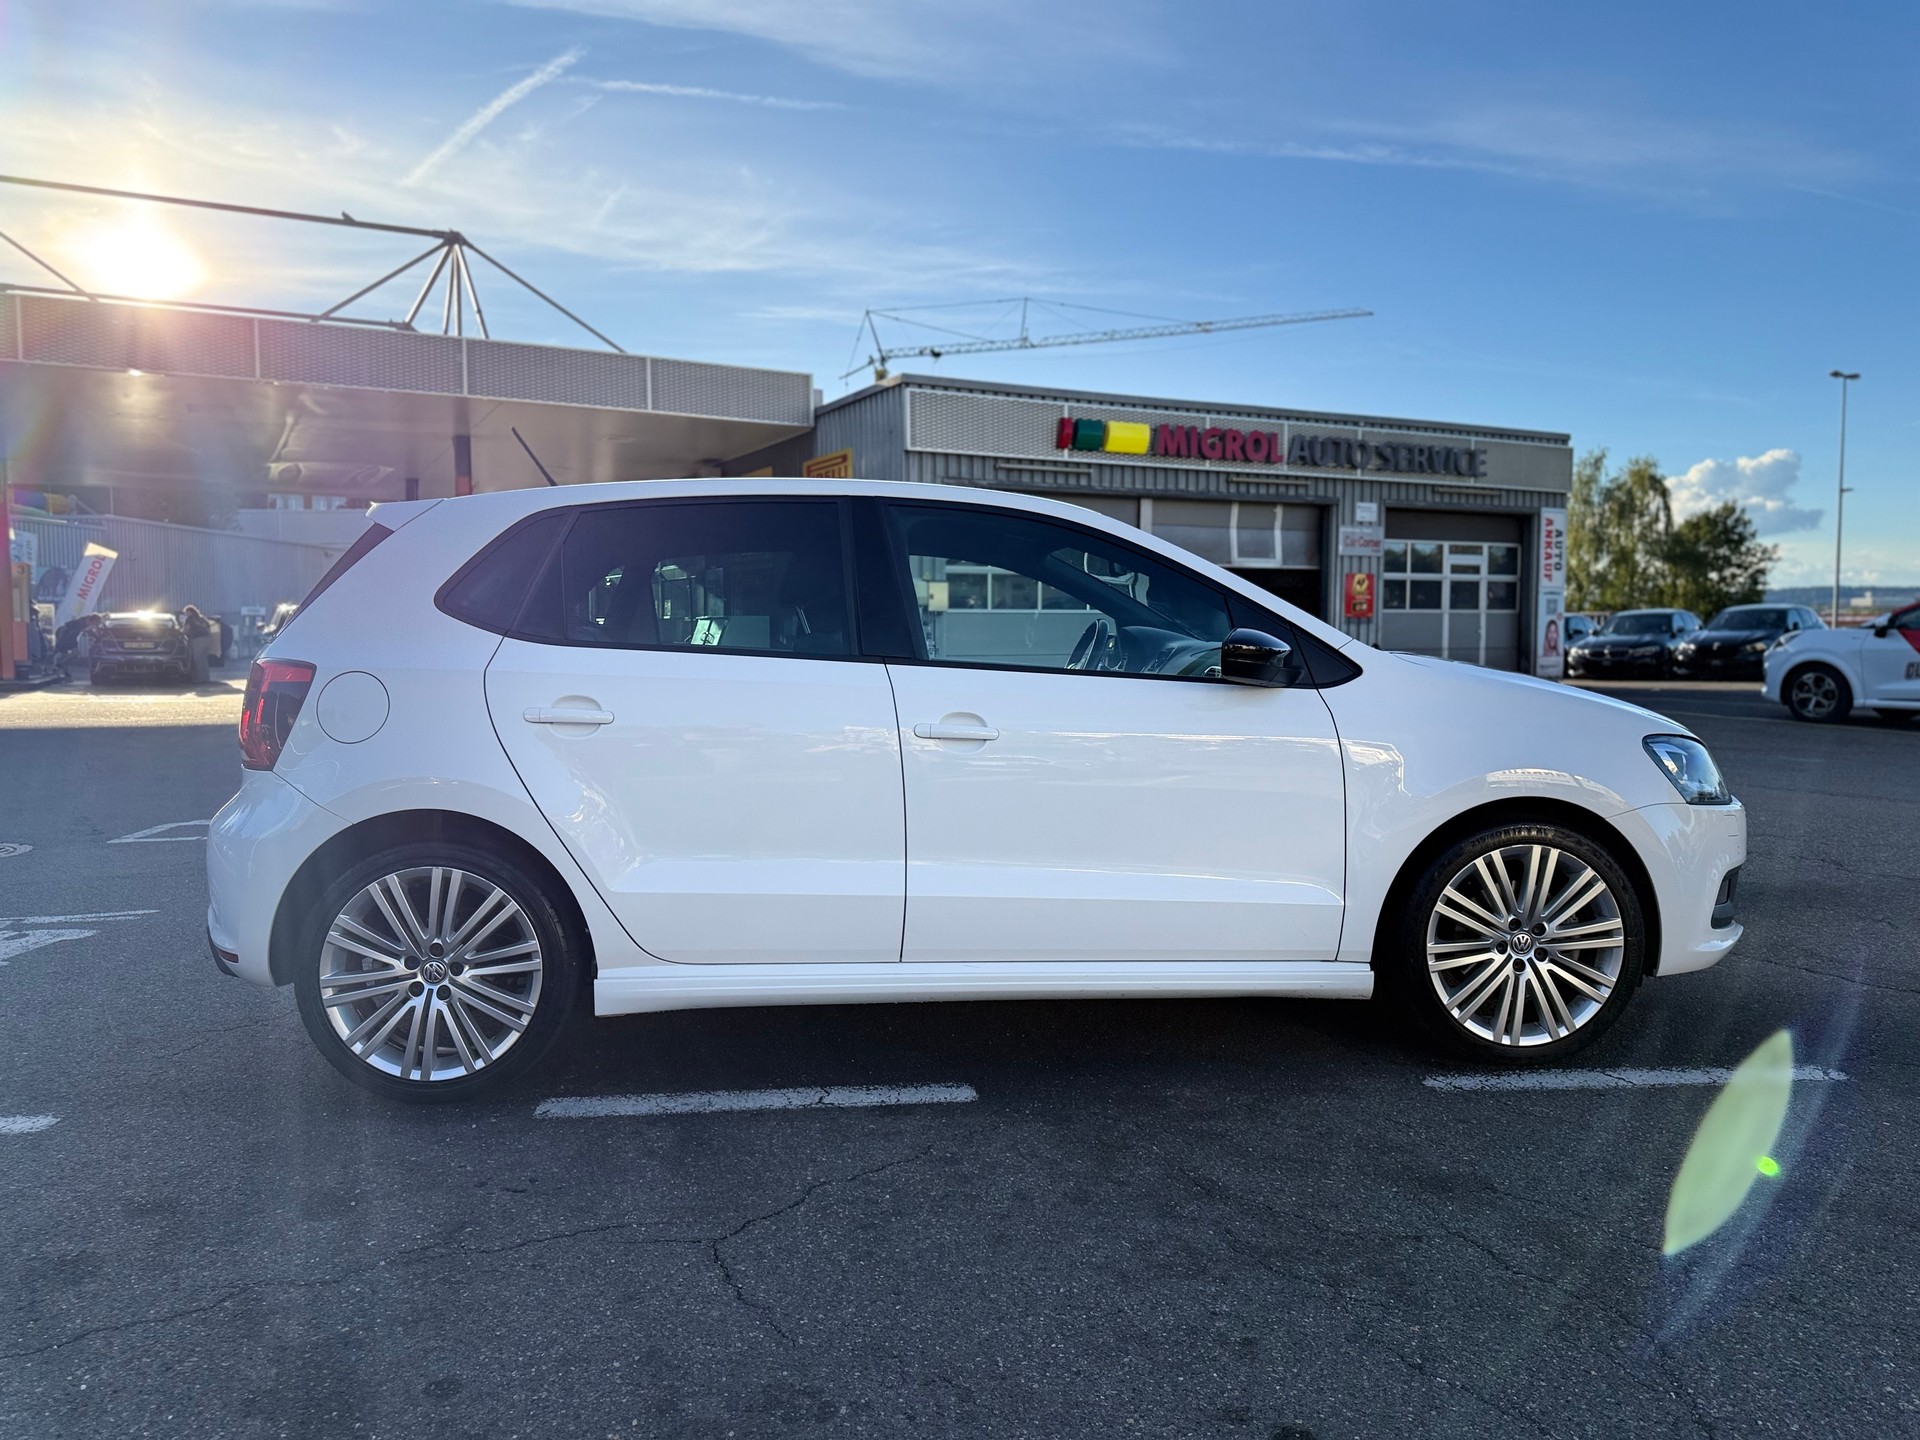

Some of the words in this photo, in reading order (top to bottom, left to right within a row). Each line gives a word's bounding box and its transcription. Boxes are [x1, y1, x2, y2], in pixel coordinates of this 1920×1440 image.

[1155, 423, 1284, 464] MIGROL
[1288, 434, 1373, 470] AUTO
[1379, 441, 1488, 478] SERVICE
[1544, 517, 1554, 583] ANKAUF
[1554, 529, 1564, 571] AUTO
[77, 556, 107, 601] MIGROL
